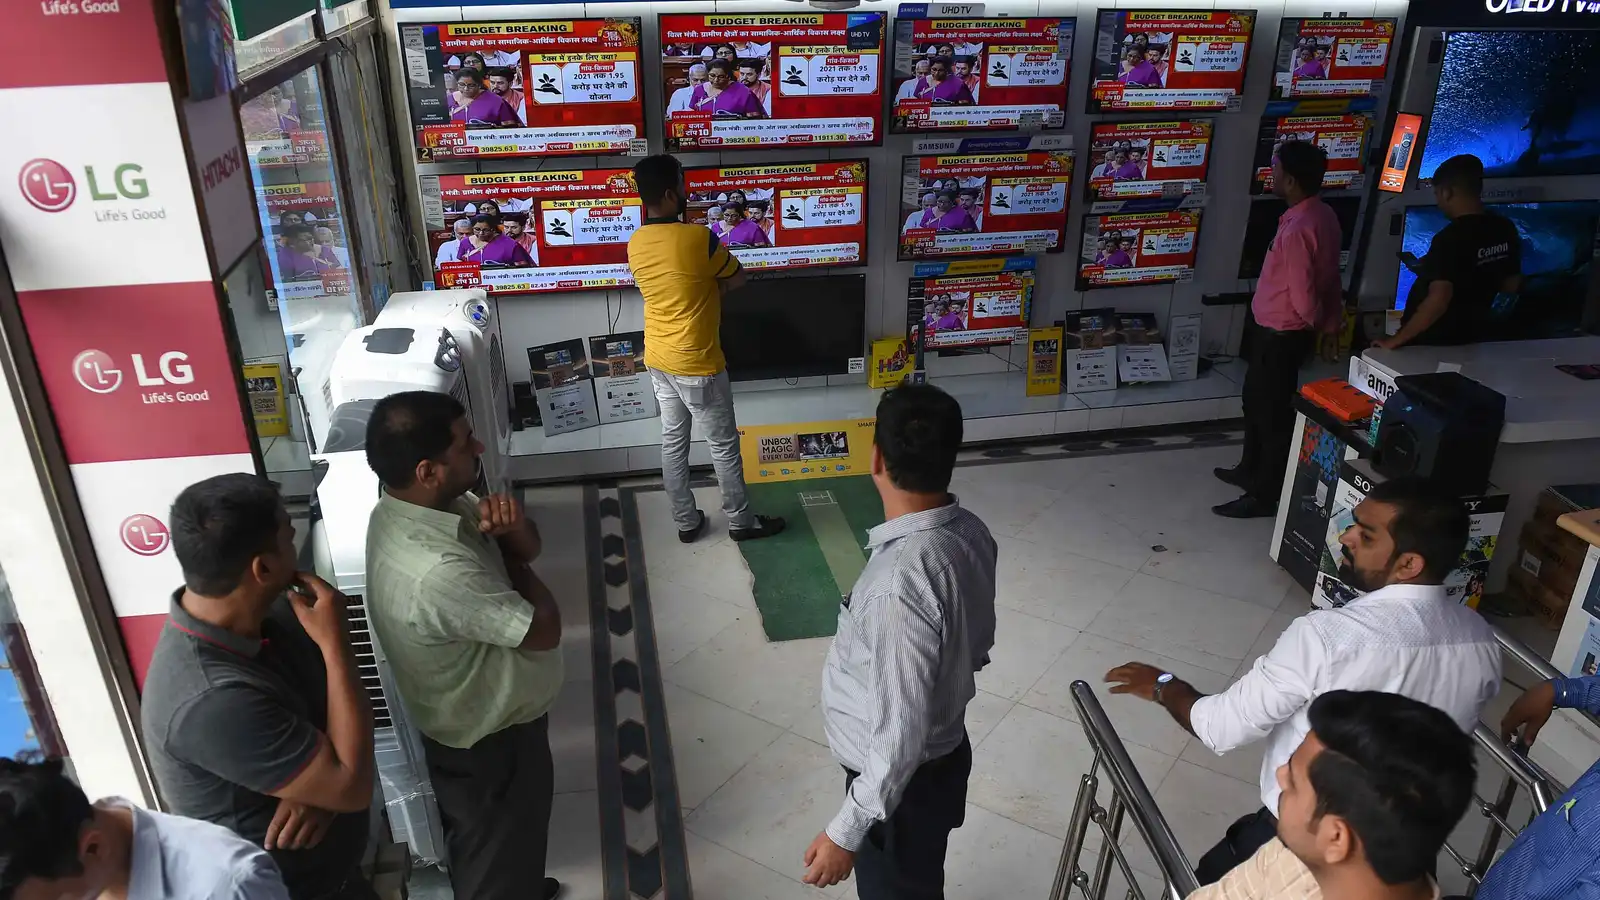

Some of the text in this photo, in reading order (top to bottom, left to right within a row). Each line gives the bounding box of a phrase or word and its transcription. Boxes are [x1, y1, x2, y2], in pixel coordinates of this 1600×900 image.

[41, 0, 120, 15] Life's Good
[1486, 0, 1555, 13] OLED
[454, 24, 567, 34] BUDGET BREAKING
[571, 82, 590, 90] करोड़
[200, 147, 241, 191] HITACHI
[84, 163, 150, 201] LG
[96, 208, 166, 222] Life's Good
[1478, 242, 1508, 258] Canon
[131, 351, 194, 386] LG
[1368, 374, 1394, 398] ama
[142, 390, 209, 404] Life's Good
[761, 437, 792, 446] UNBOX
[1354, 475, 1374, 492] SO
